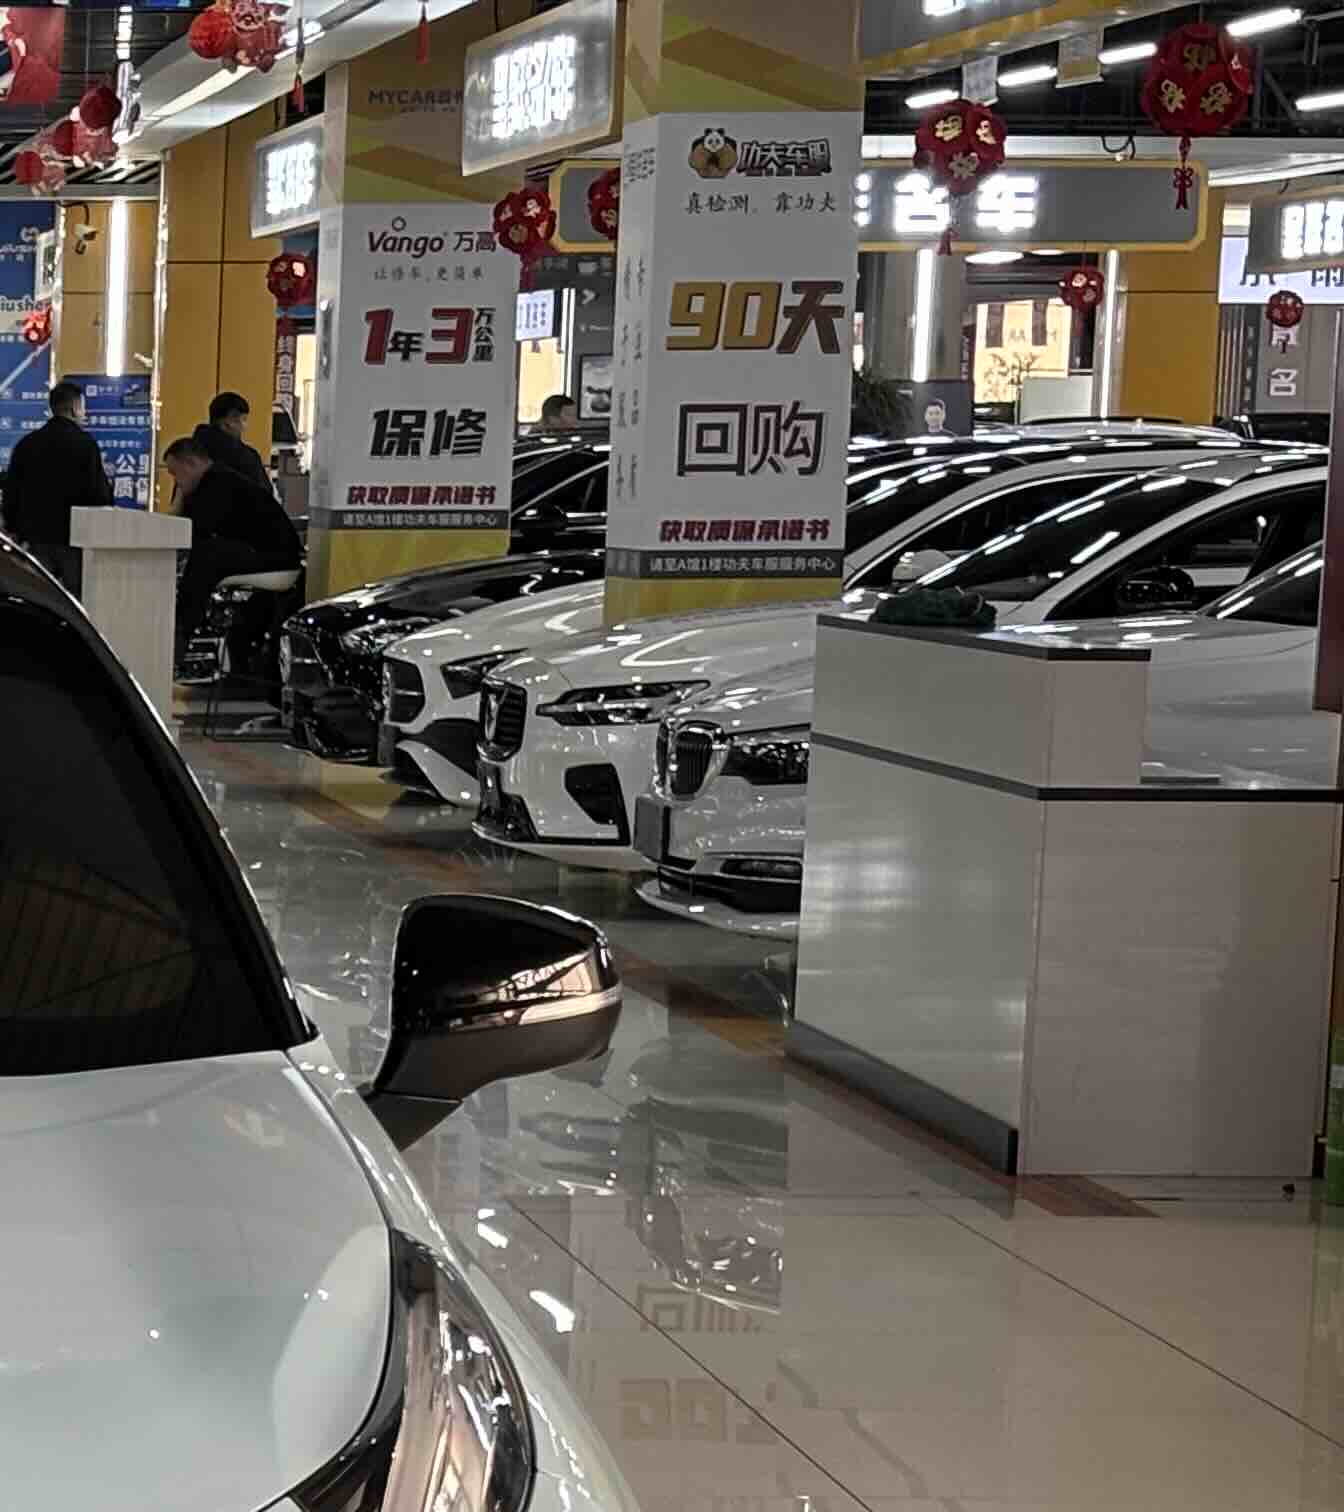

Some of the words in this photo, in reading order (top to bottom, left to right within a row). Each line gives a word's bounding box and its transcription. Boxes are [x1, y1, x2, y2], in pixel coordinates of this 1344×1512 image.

[368, 231, 445, 258] Vango
[665, 281, 845, 354] 90天
[370, 408, 488, 457] 保修
[677, 402, 824, 477] 回购
